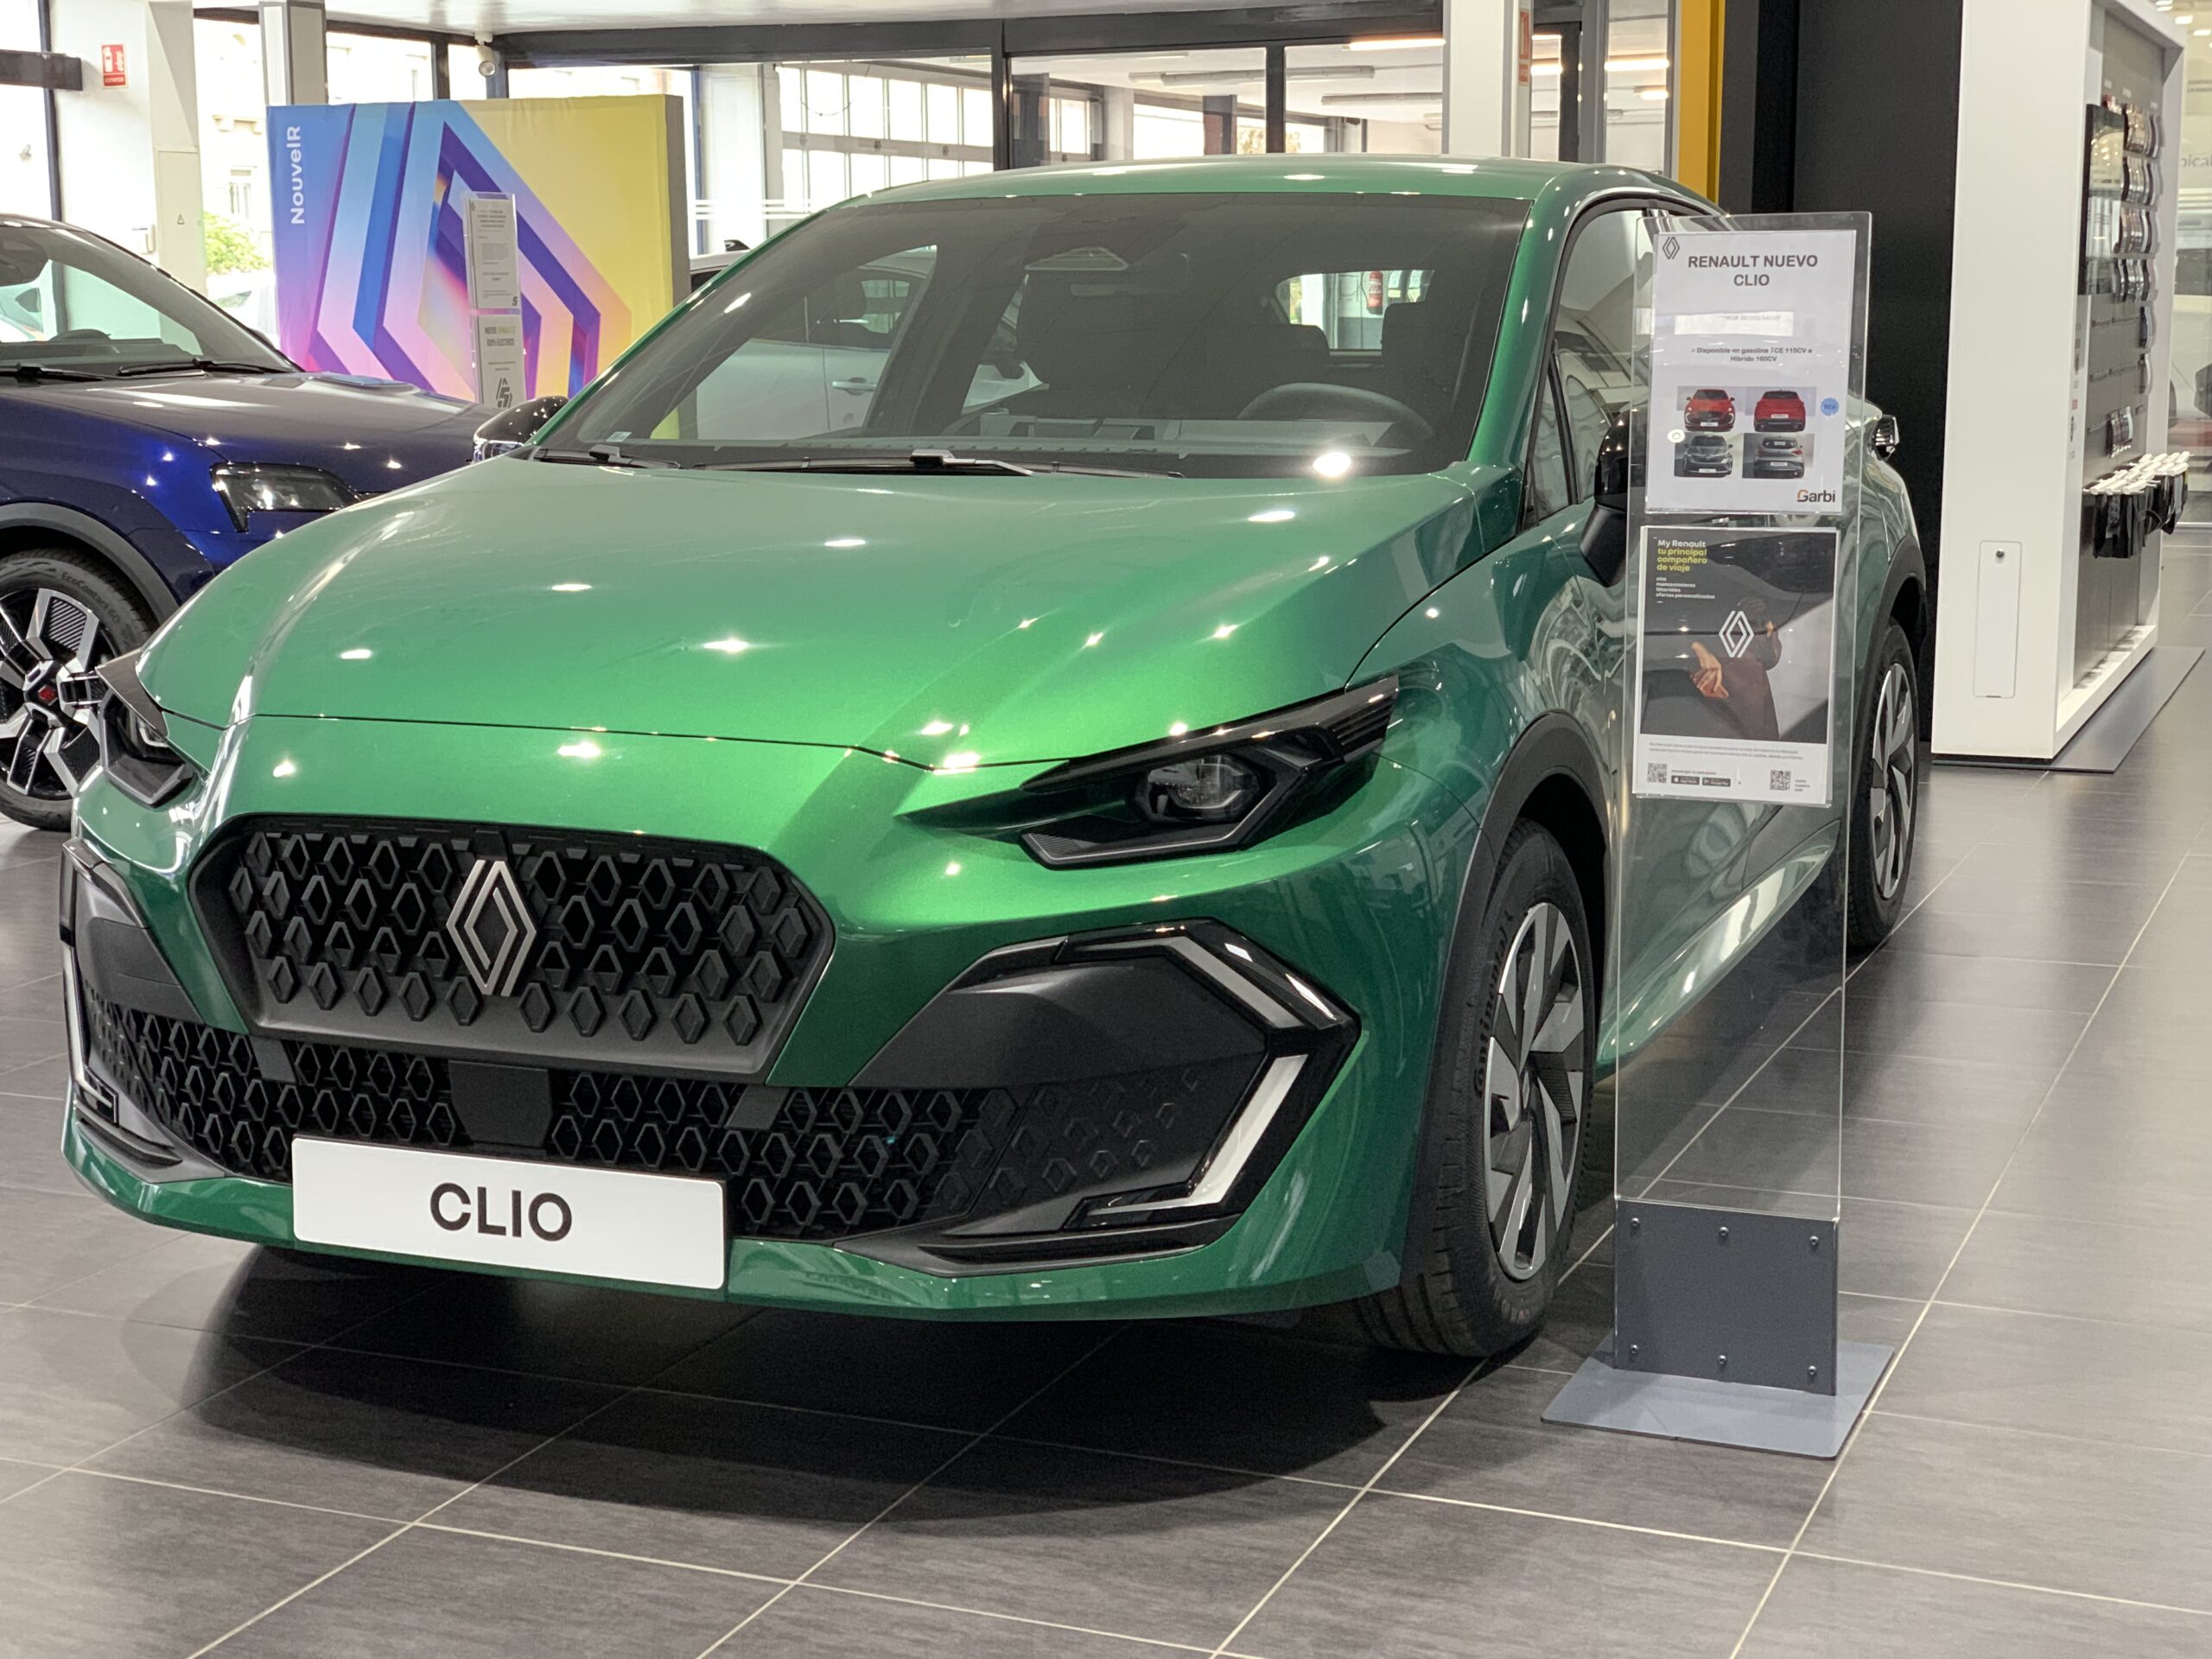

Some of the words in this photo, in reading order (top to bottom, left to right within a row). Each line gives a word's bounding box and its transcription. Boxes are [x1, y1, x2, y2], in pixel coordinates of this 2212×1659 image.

[1688, 256, 1760, 268] RENAULT
[1764, 255, 1818, 268] NUEVO
[1733, 274, 1770, 286] CLIO
[1796, 489, 1836, 503] Garbi
[1657, 539, 1671, 549] My
[1672, 539, 1707, 548] Renault
[1668, 548, 1707, 556] principal
[1656, 556, 1708, 564] compañero
[1669, 563, 1691, 573] viaje
[429, 1182, 573, 1243] CLIO
